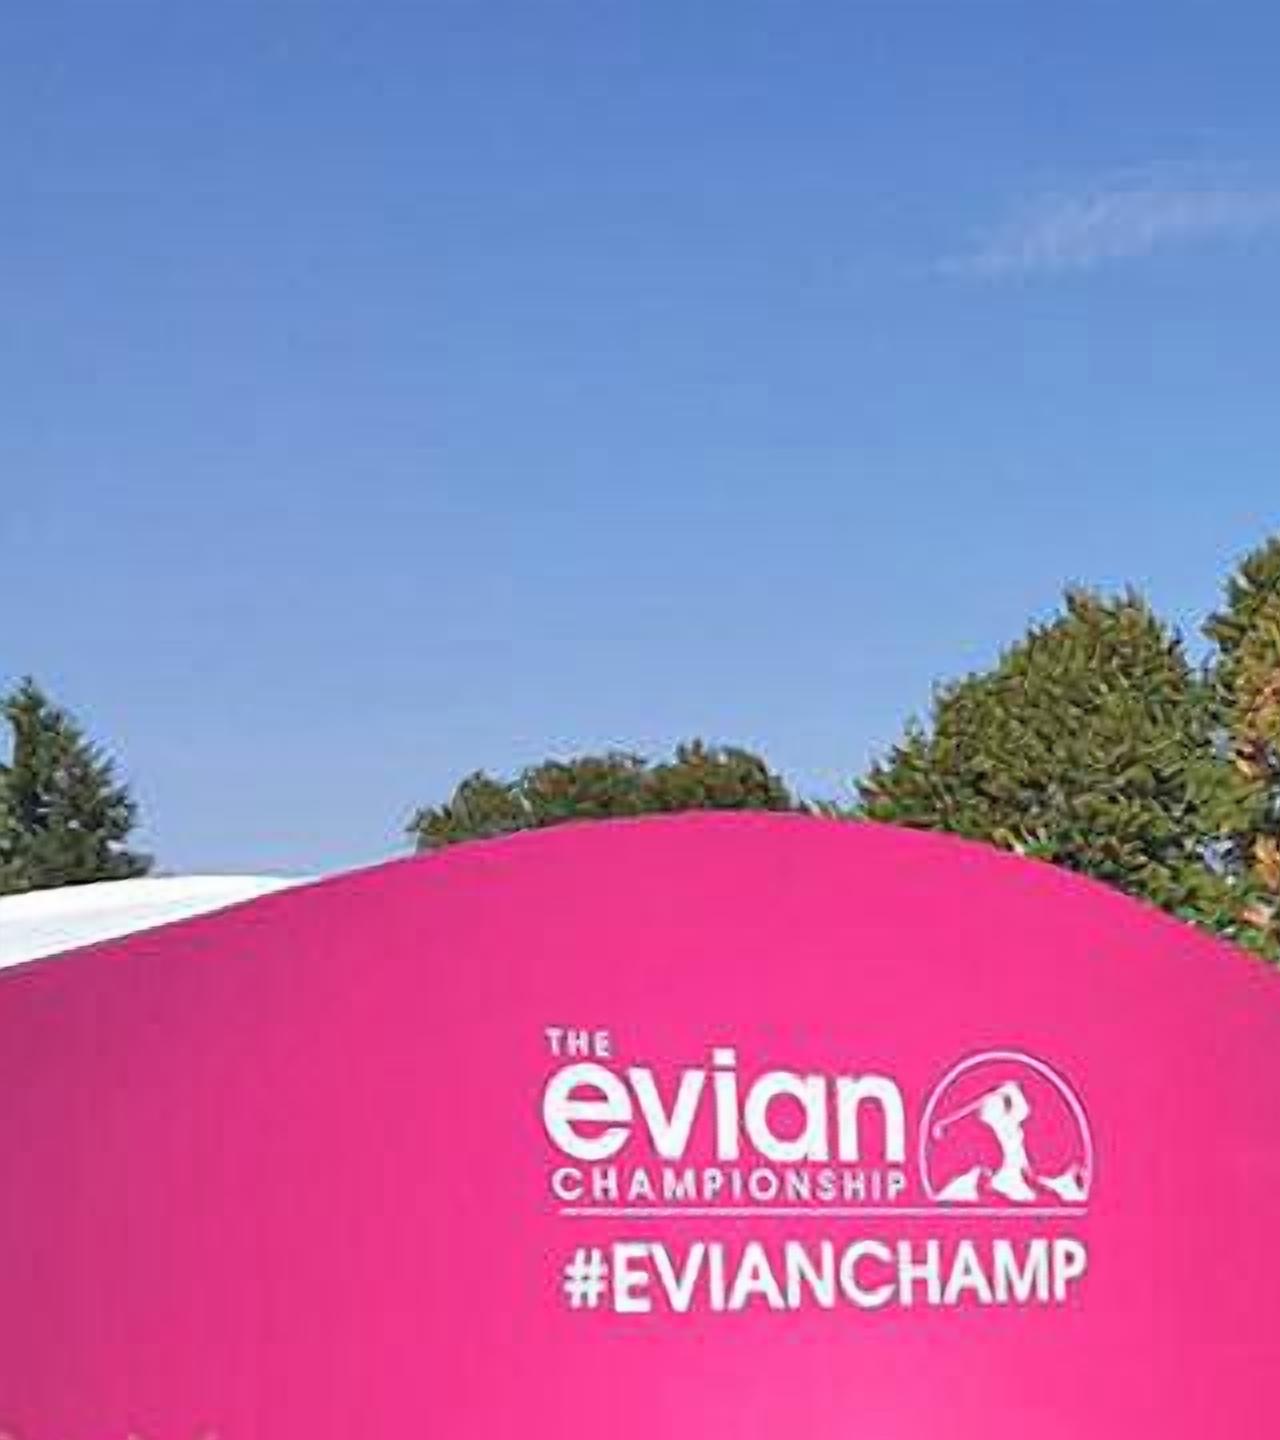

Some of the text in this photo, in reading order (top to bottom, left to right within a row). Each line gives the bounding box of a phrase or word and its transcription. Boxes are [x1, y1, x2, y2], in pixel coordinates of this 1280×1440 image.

[545, 1027, 610, 1056] THE
[543, 1048, 904, 1162] evian
[551, 1166, 907, 1201] CHAMPIONSHIP
[564, 1238, 1087, 1313] #EVIANCHAMP
